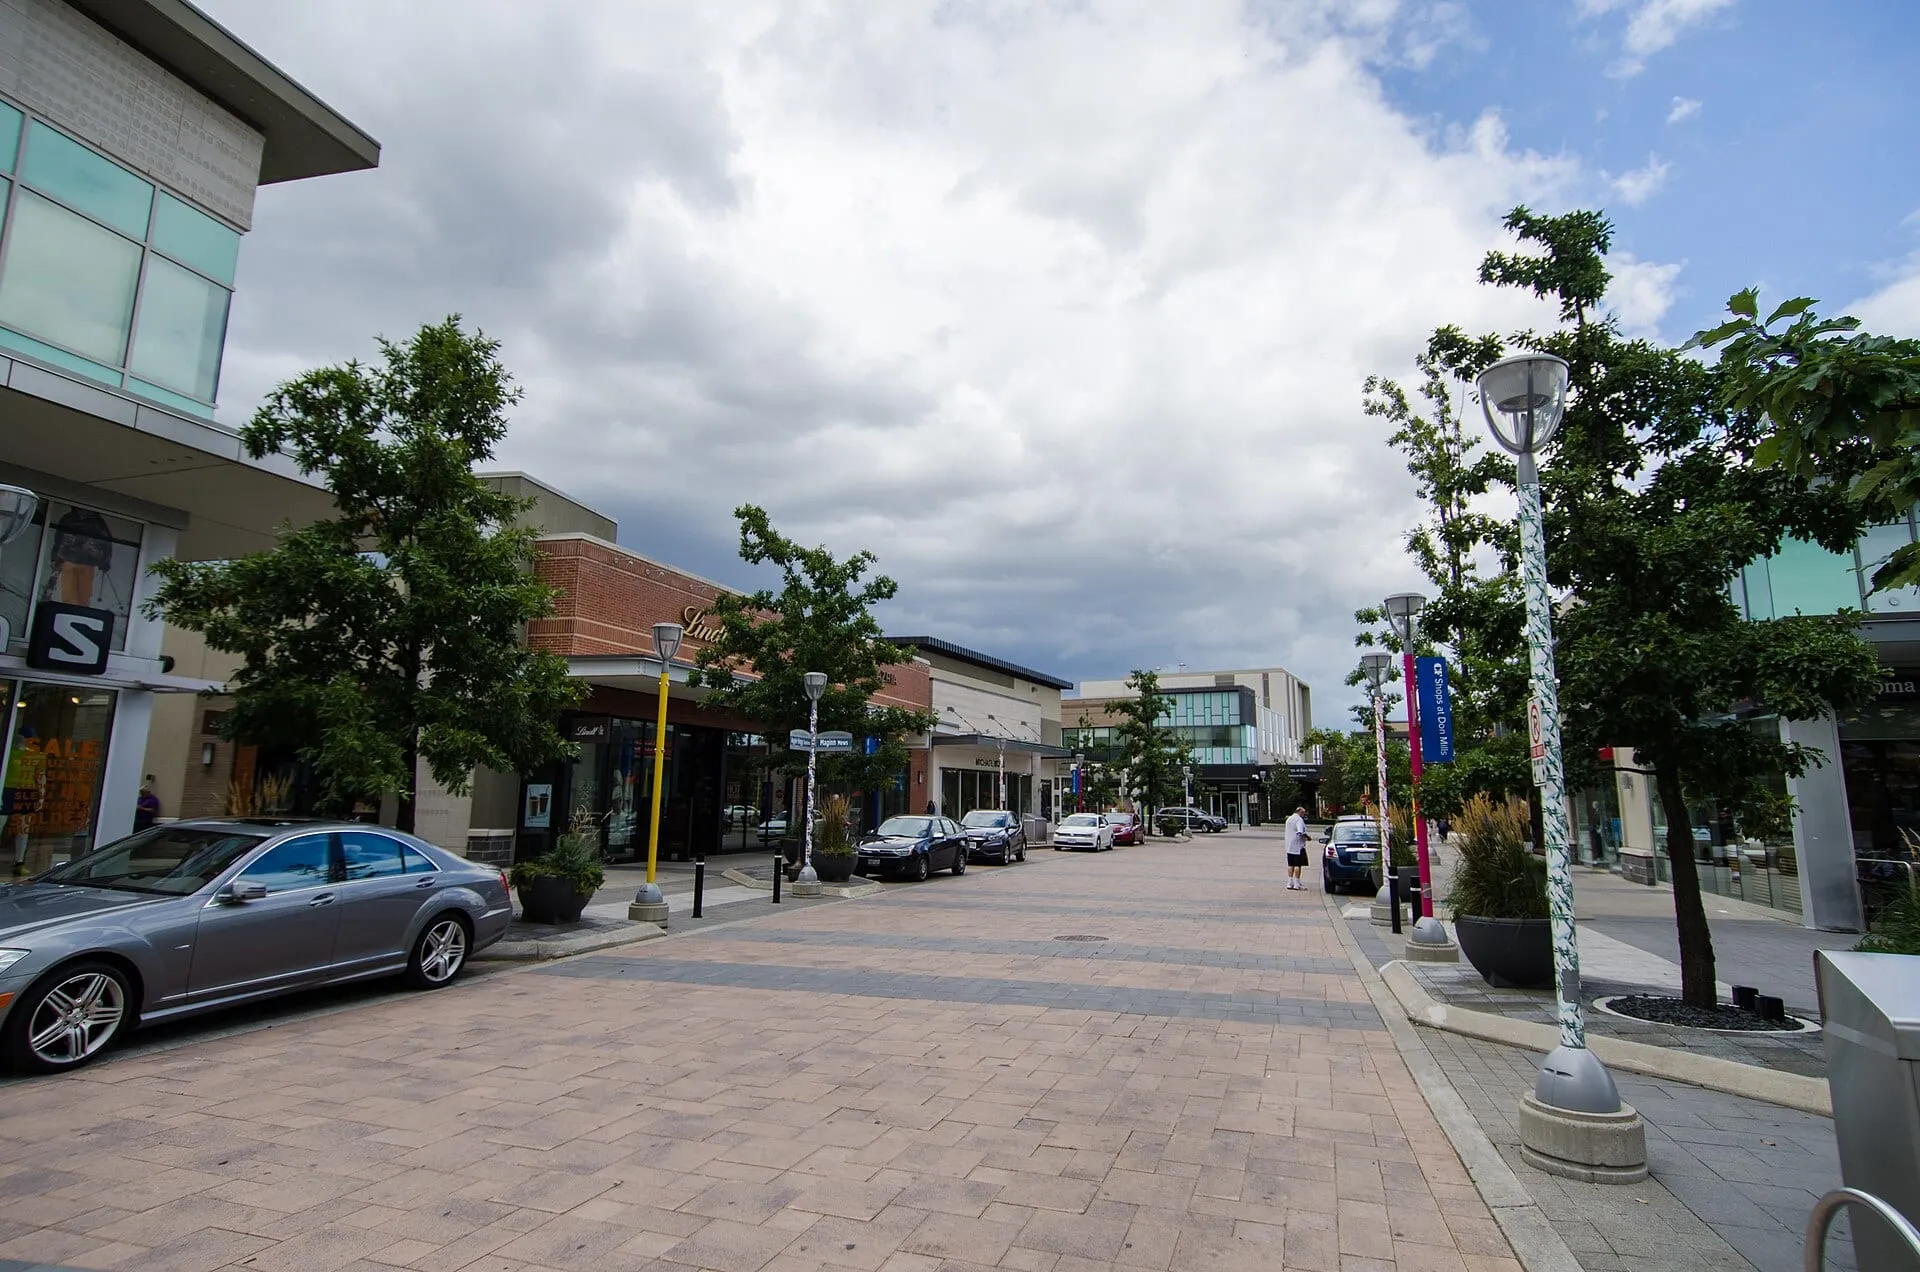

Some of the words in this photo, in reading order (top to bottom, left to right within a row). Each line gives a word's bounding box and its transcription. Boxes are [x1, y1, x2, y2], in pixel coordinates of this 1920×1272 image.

[1434, 678, 1444, 704] Shops
[1436, 707, 1445, 715] at
[1437, 716, 1446, 734] Don
[24, 737, 101, 758] SALE
[1439, 737, 1449, 755] Mills
